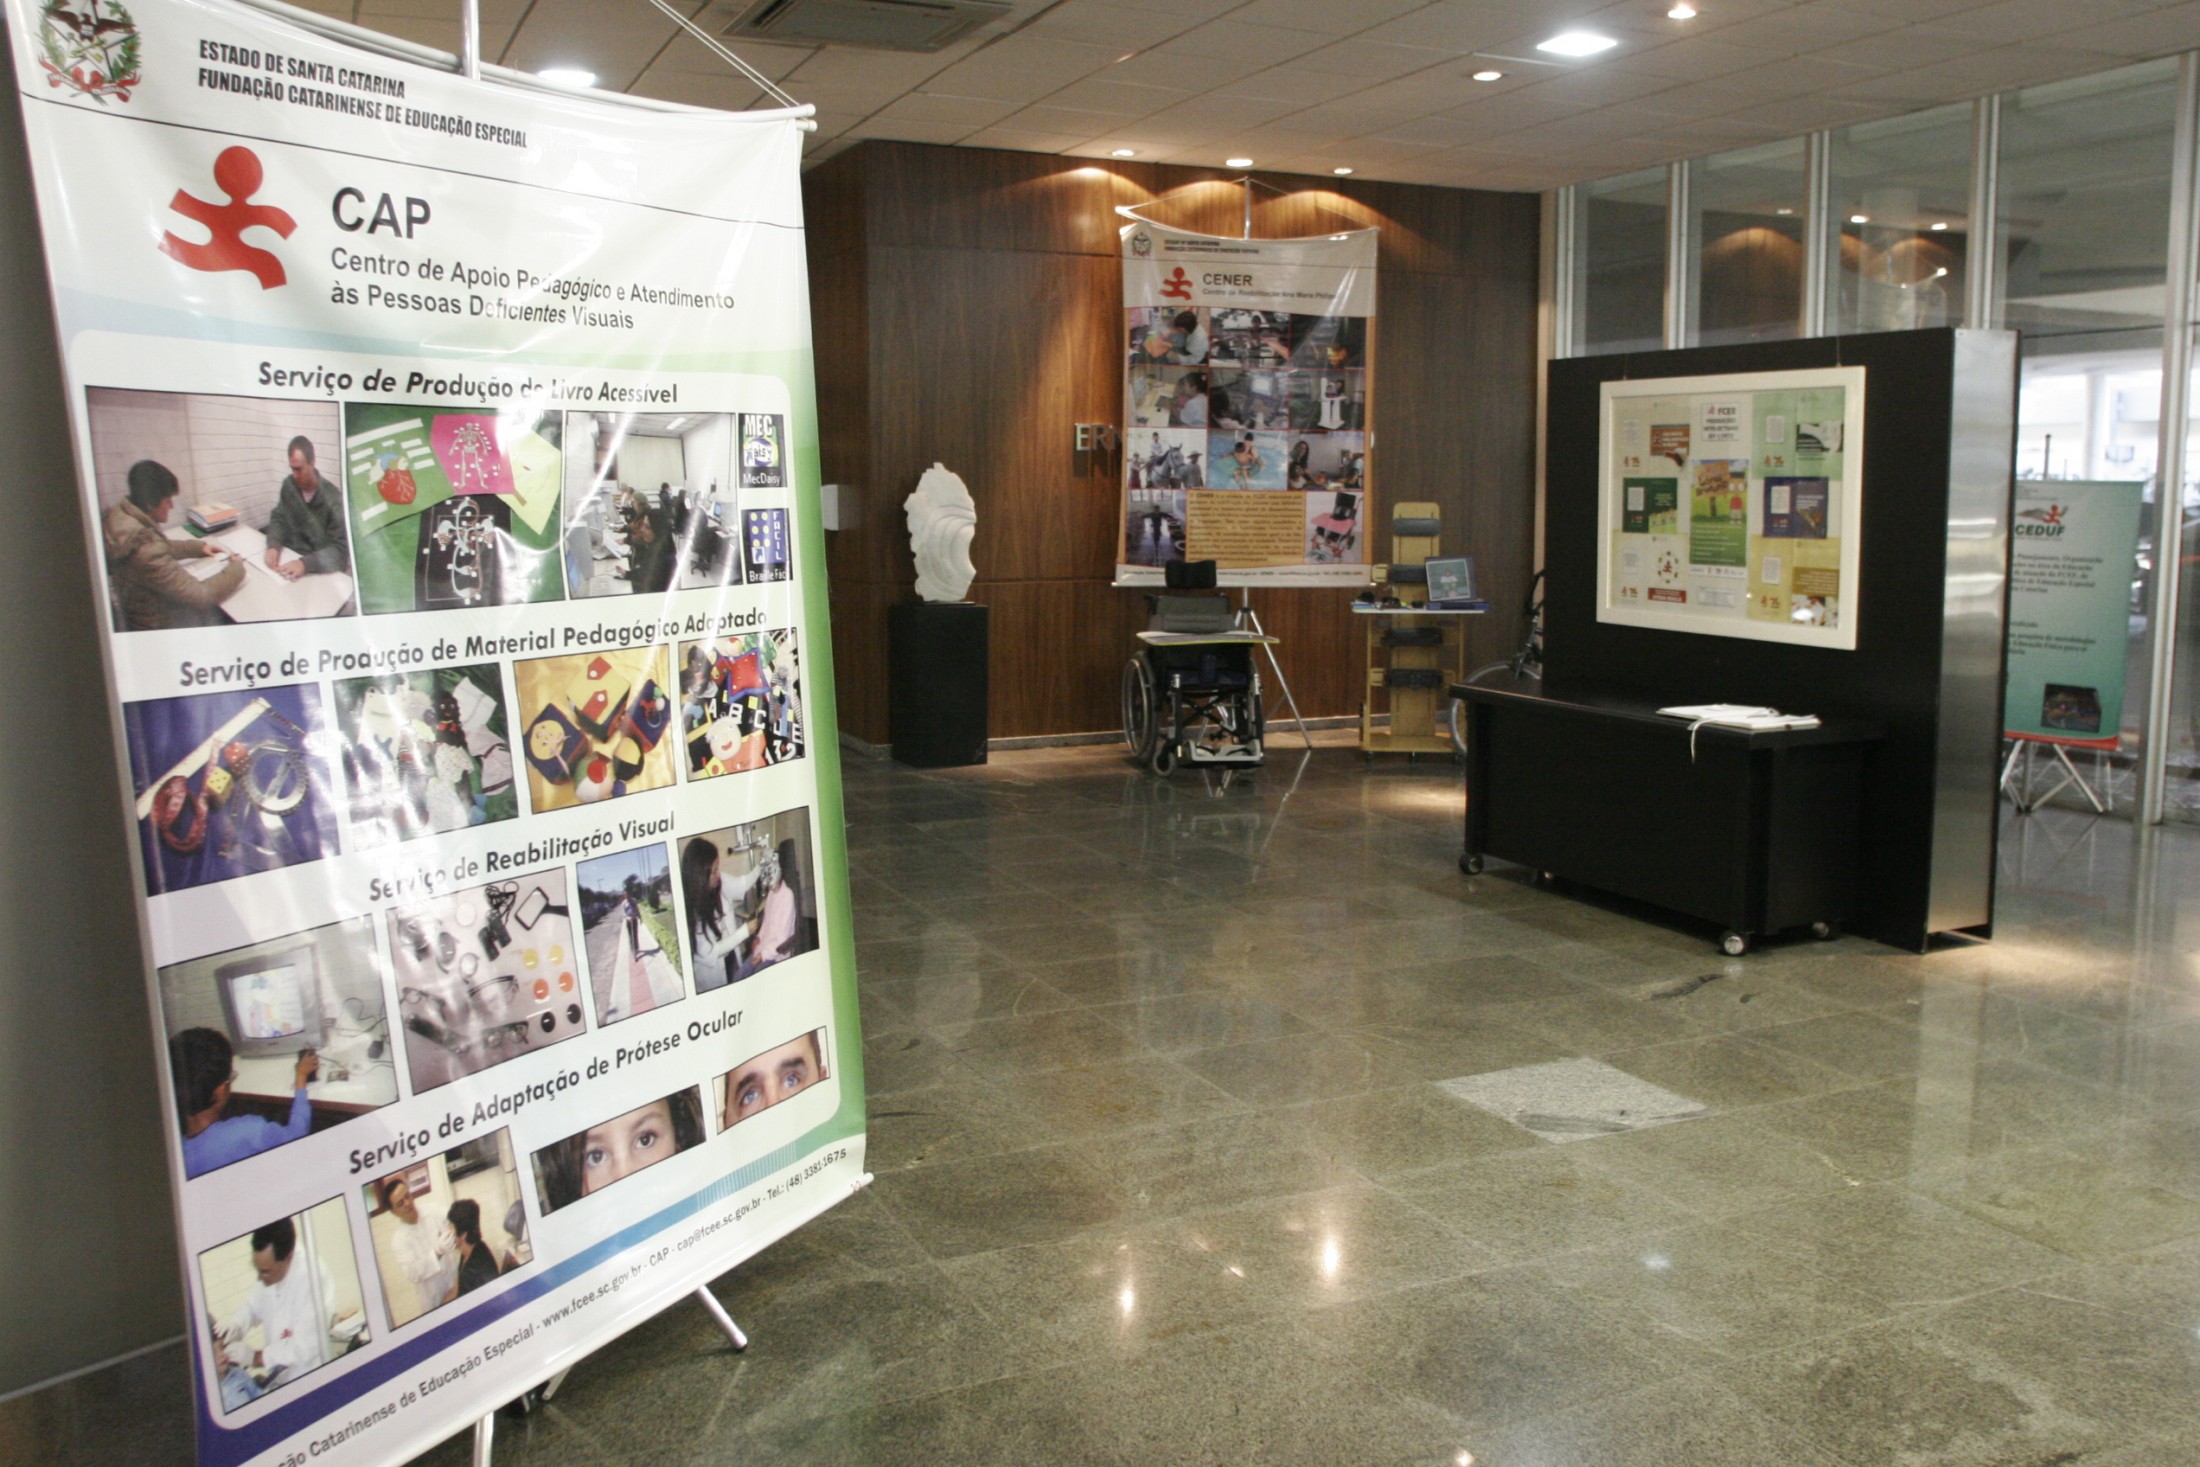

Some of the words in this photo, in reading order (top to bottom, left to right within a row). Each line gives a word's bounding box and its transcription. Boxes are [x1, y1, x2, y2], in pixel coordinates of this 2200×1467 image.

[199, 39, 261, 70] ESTADO
[264, 52, 284, 75] DE
[287, 57, 335, 85] SANTA
[337, 67, 405, 99] CATARINA
[198, 67, 285, 102] FUNDAÇÃO
[287, 84, 383, 121] CATARINENSE
[384, 103, 403, 125] DE
[404, 107, 473, 138] EDUCAÇÃO
[474, 121, 527, 148] ESPECIAL
[331, 186, 431, 240] CAP
[330, 246, 411, 277] Centro
[417, 257, 445, 281] de
[450, 261, 511, 290] Apoio
[516, 268, 612, 302] Pedagógico
[616, 286, 626, 302] e
[630, 283, 735, 309] Atendimento
[330, 281, 359, 305] às
[367, 284, 462, 315] Pessoas
[469, 294, 567, 324] Deficientes
[572, 304, 634, 330] Visuais
[1202, 272, 1253, 286] CENER
[258, 361, 353, 397] Serviço
[362, 368, 397, 393] de
[405, 371, 513, 404] Produção
[551, 378, 594, 402] Livro
[597, 381, 678, 404] Acessível
[744, 414, 773, 437] MEC
[743, 472, 781, 486] MecDaisy
[2014, 524, 2065, 537] CEDUF
[179, 656, 272, 687] Serviço
[279, 651, 310, 677] de
[318, 642, 424, 673] Produção
[431, 637, 458, 662] de
[464, 627, 555, 658] Material
[563, 618, 680, 650] Pedagógico
[684, 607, 767, 634] Adaptado
[369, 868, 446, 902] Serviço
[453, 856, 480, 881] de
[486, 828, 613, 873] Reabilitação
[619, 811, 675, 841] Visual
[349, 1129, 431, 1175] Serviço
[437, 1112, 465, 1139] de
[471, 1069, 580, 1127] Adaptação
[586, 1056, 610, 1080] de
[616, 1033, 681, 1069] Prótese
[686, 1010, 743, 1042] Ocular
[309, 1401, 396, 1457] Catarinense
[400, 1393, 417, 1409] de
[419, 1355, 483, 1397] Educação
[484, 1323, 535, 1362] Especial
[542, 1264, 642, 1328] www.fcee.sc.gov.br
[649, 1247, 669, 1267] CAP
[676, 1197, 762, 1251] cap@fcee.sc.gov.br
[785, 1172, 803, 1192] (48)
[803, 1148, 847, 1180] 3381-1675
